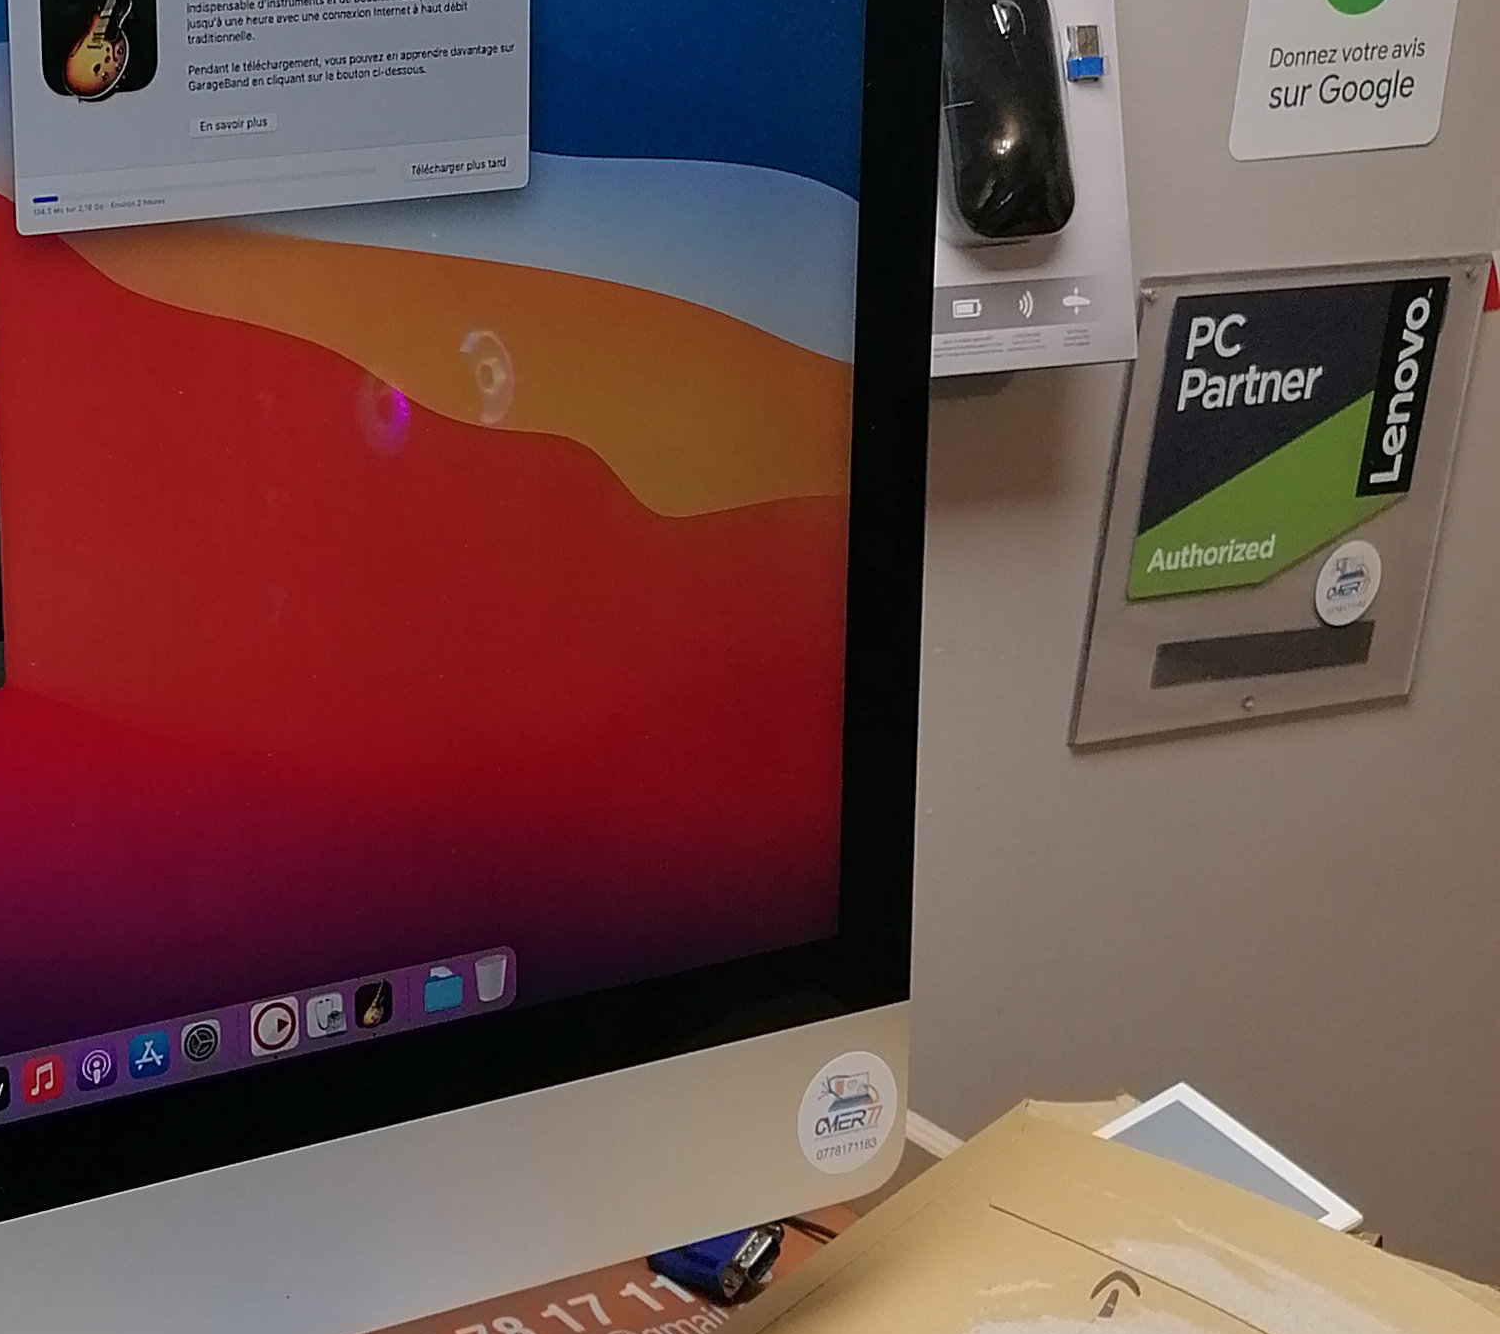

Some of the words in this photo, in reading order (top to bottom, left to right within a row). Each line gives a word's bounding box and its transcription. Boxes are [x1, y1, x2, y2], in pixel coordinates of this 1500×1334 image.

[1269, 47, 1338, 68] Donnez
[1342, 43, 1388, 63] votre
[1391, 37, 1426, 60] avis
[1269, 83, 1313, 109] sur
[1319, 69, 1415, 109] Google
[200, 121, 212, 132] En
[214, 118, 244, 130] savoir
[246, 116, 268, 130] plus
[1186, 313, 1249, 360] PC
[1176, 365, 1324, 412] Partner
[1369, 294, 1430, 484] Lenovo
[1146, 533, 1276, 574] Authorized
[541, 1293, 613, 1334] 17
[619, 1274, 695, 1313] 11
